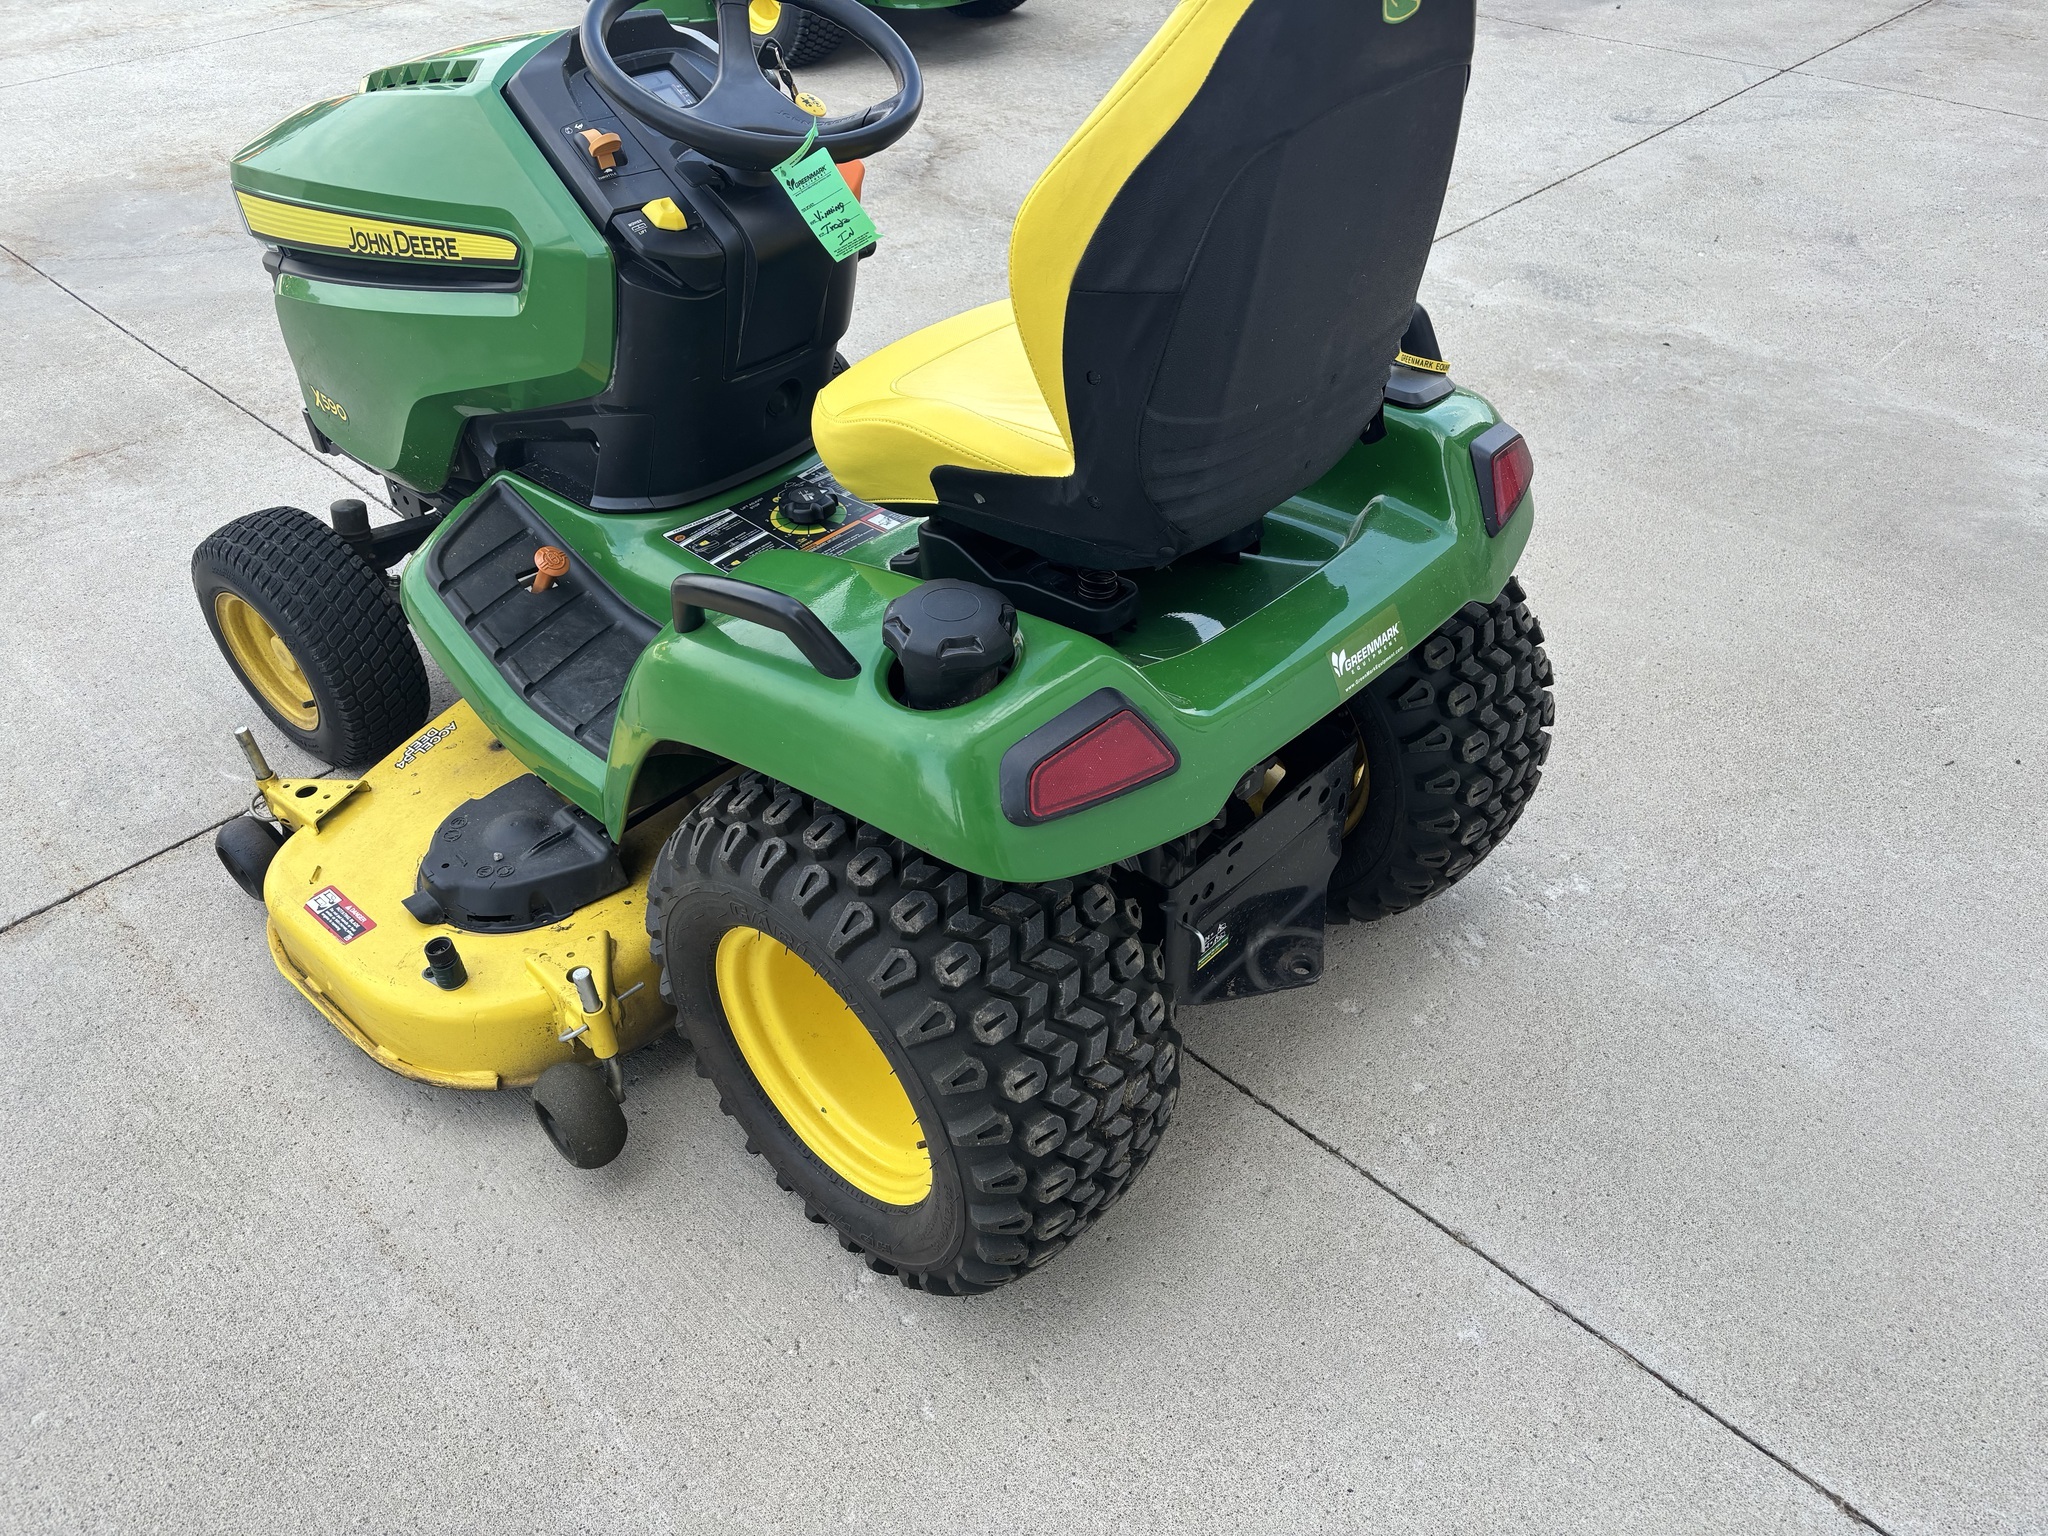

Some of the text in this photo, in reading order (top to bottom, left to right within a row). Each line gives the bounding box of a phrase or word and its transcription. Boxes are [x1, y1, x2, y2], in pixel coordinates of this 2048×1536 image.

[349, 227, 461, 259] JOHN DEERE
[310, 384, 348, 421] X590
[1344, 622, 1399, 672] GREENMARK
[1351, 637, 1397, 675] EQUIPMENT
[404, 727, 439, 757] DEEP
[415, 721, 457, 754] ACCEL
